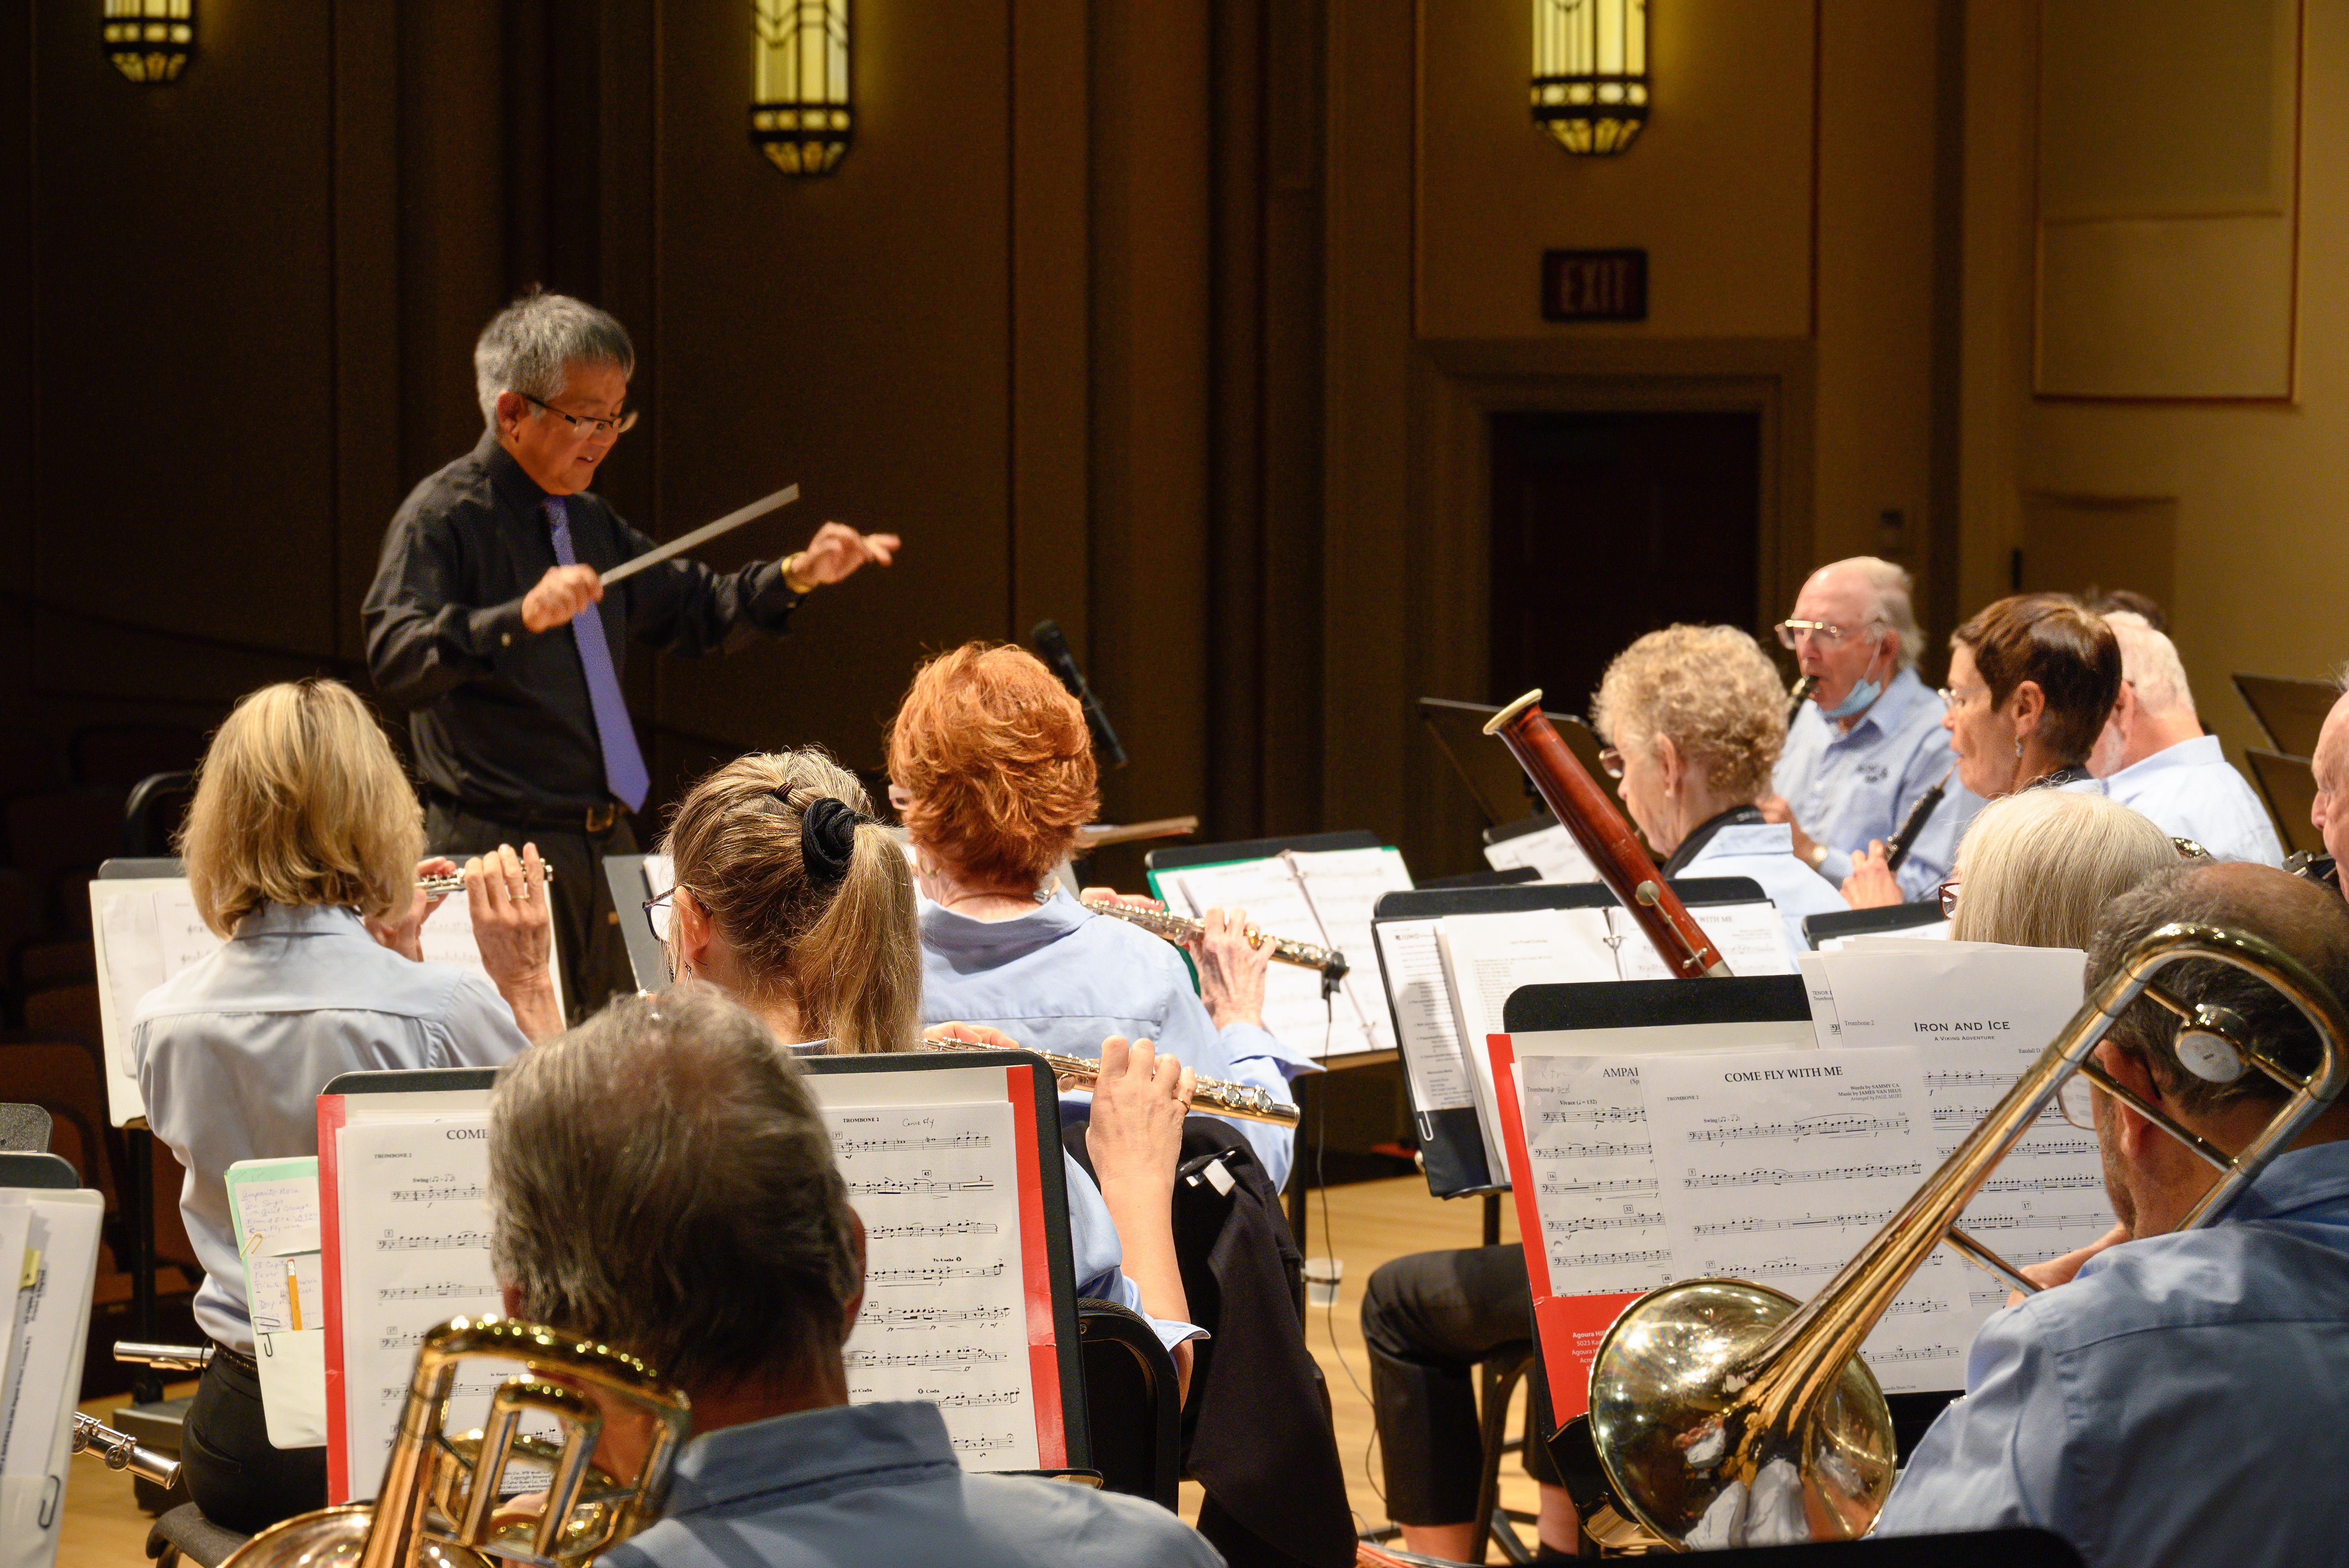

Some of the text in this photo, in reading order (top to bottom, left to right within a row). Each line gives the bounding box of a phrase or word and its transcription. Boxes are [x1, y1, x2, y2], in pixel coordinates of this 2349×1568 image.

[1561, 258, 1628, 311] EXIT
[1914, 1021, 2010, 1032] IRON AND ICE
[1725, 1066, 1843, 1082] COME FLY WITH ME
[446, 1130, 489, 1140] COME
